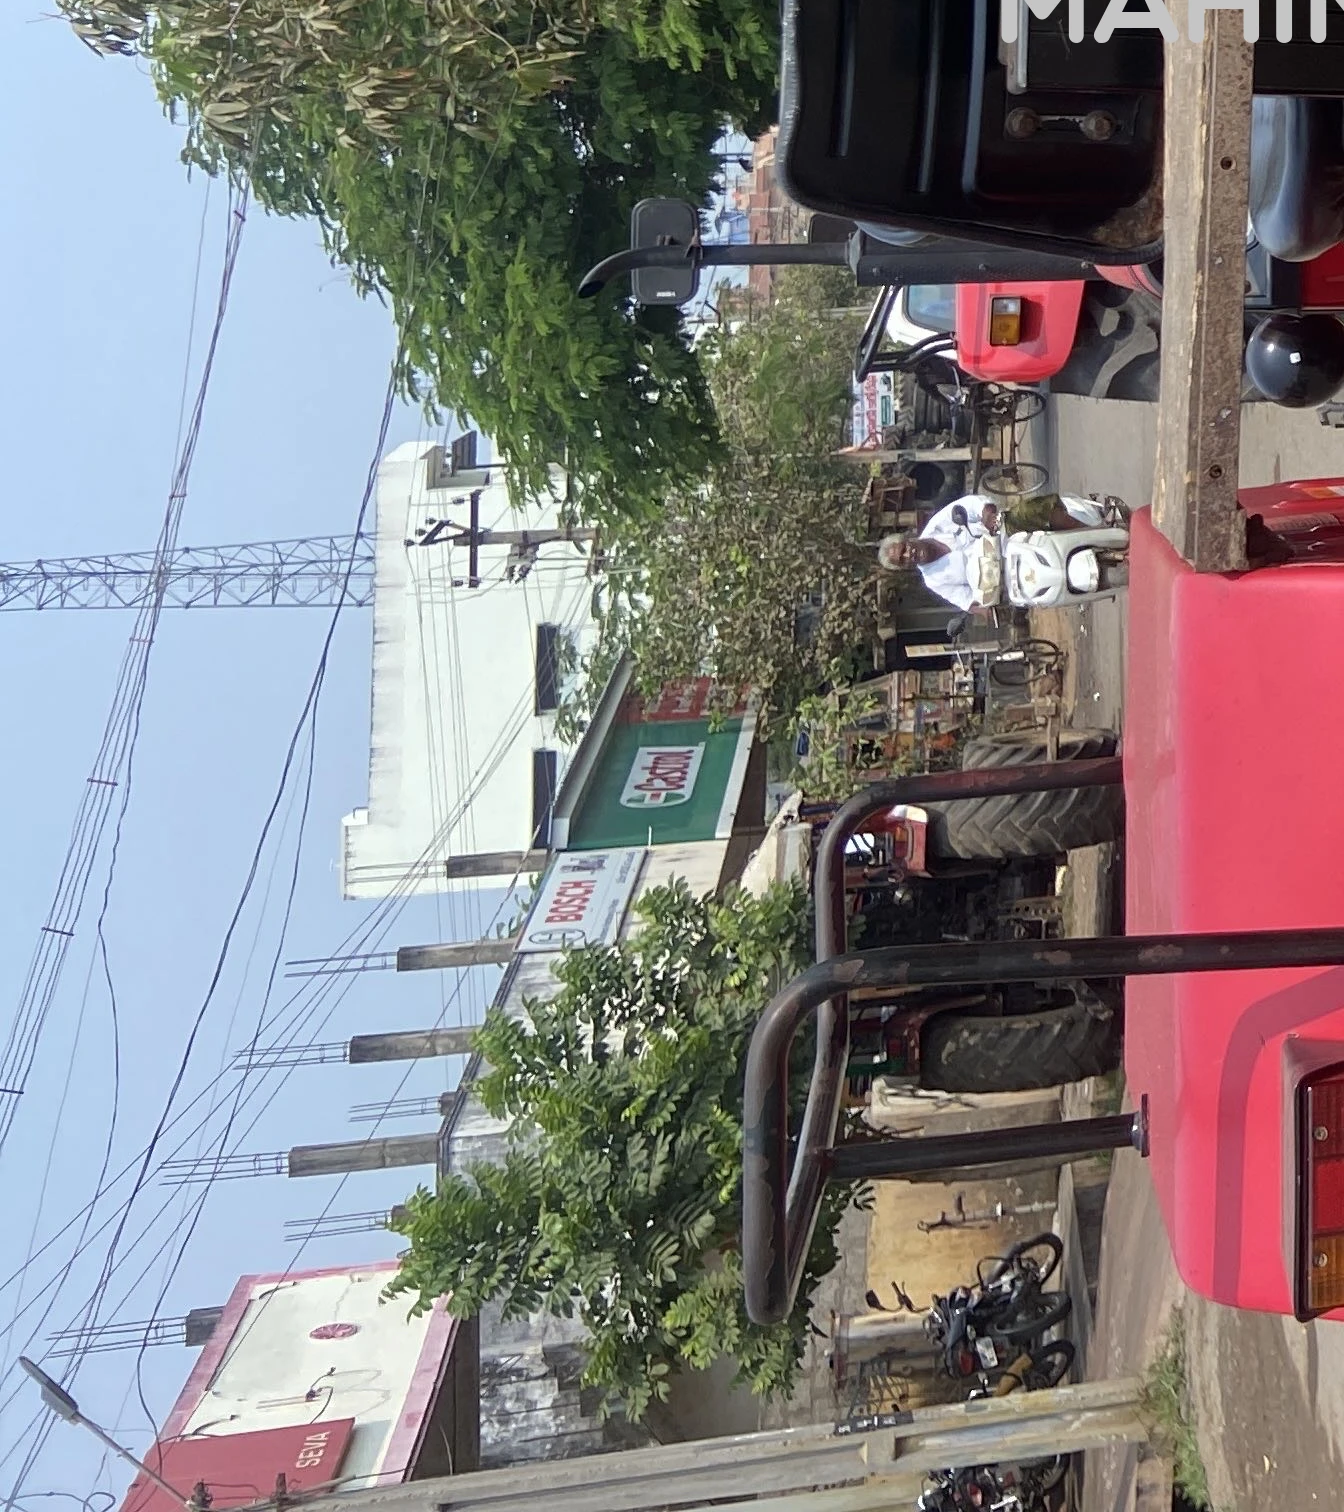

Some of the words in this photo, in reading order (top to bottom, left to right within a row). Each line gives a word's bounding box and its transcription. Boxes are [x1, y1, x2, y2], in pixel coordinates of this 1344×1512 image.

[633, 749, 695, 792] Castrol
[544, 879, 597, 924] BOSCH
[295, 1431, 331, 1469] SEVA
